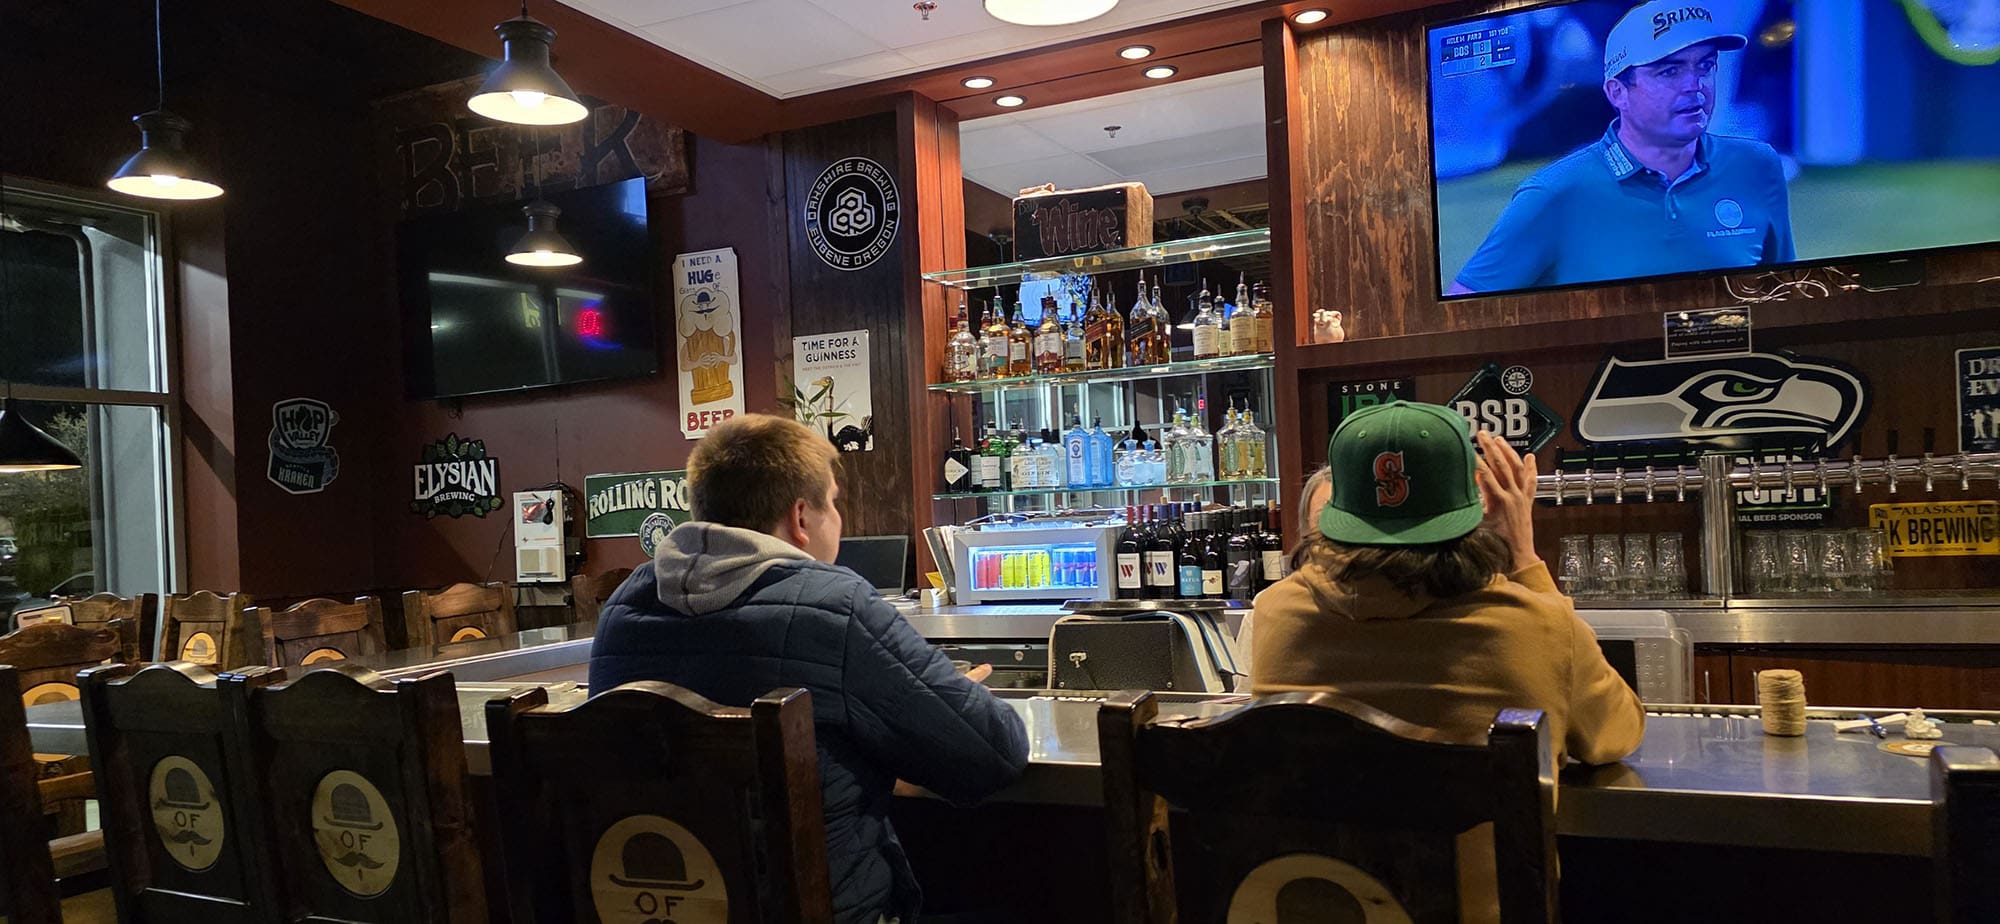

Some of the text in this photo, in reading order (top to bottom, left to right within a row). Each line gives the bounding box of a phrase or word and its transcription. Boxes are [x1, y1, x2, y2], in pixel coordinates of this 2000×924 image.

[1652, 7, 1712, 39] SRIXON
[1453, 45, 1469, 57] BOS
[807, 161, 896, 220] OAKSHIRE BREWING
[1031, 198, 1120, 257] Wine
[808, 219, 896, 266] EUGENE OREGON
[689, 256, 712, 267] NEED
[715, 254, 722, 264] A
[801, 336, 859, 351] TIME FOR A
[805, 349, 856, 363] GUINNESS
[1341, 381, 1400, 393] STONE
[1341, 391, 1397, 419] IP
[1456, 398, 1530, 438] BSB
[278, 466, 315, 489] KRAKEN
[414, 459, 496, 500] ELYSIAN
[1372, 450, 1411, 507] S
[433, 491, 476, 504] BREWING
[589, 476, 691, 520] ROLLING RO
[1778, 512, 1823, 521] SPONSOR
[1901, 505, 1966, 515] ALASKA
[1907, 516, 1994, 545] BREWING
[173, 811, 201, 829] OF
[340, 830, 371, 850] OF
[635, 891, 684, 916] OF
